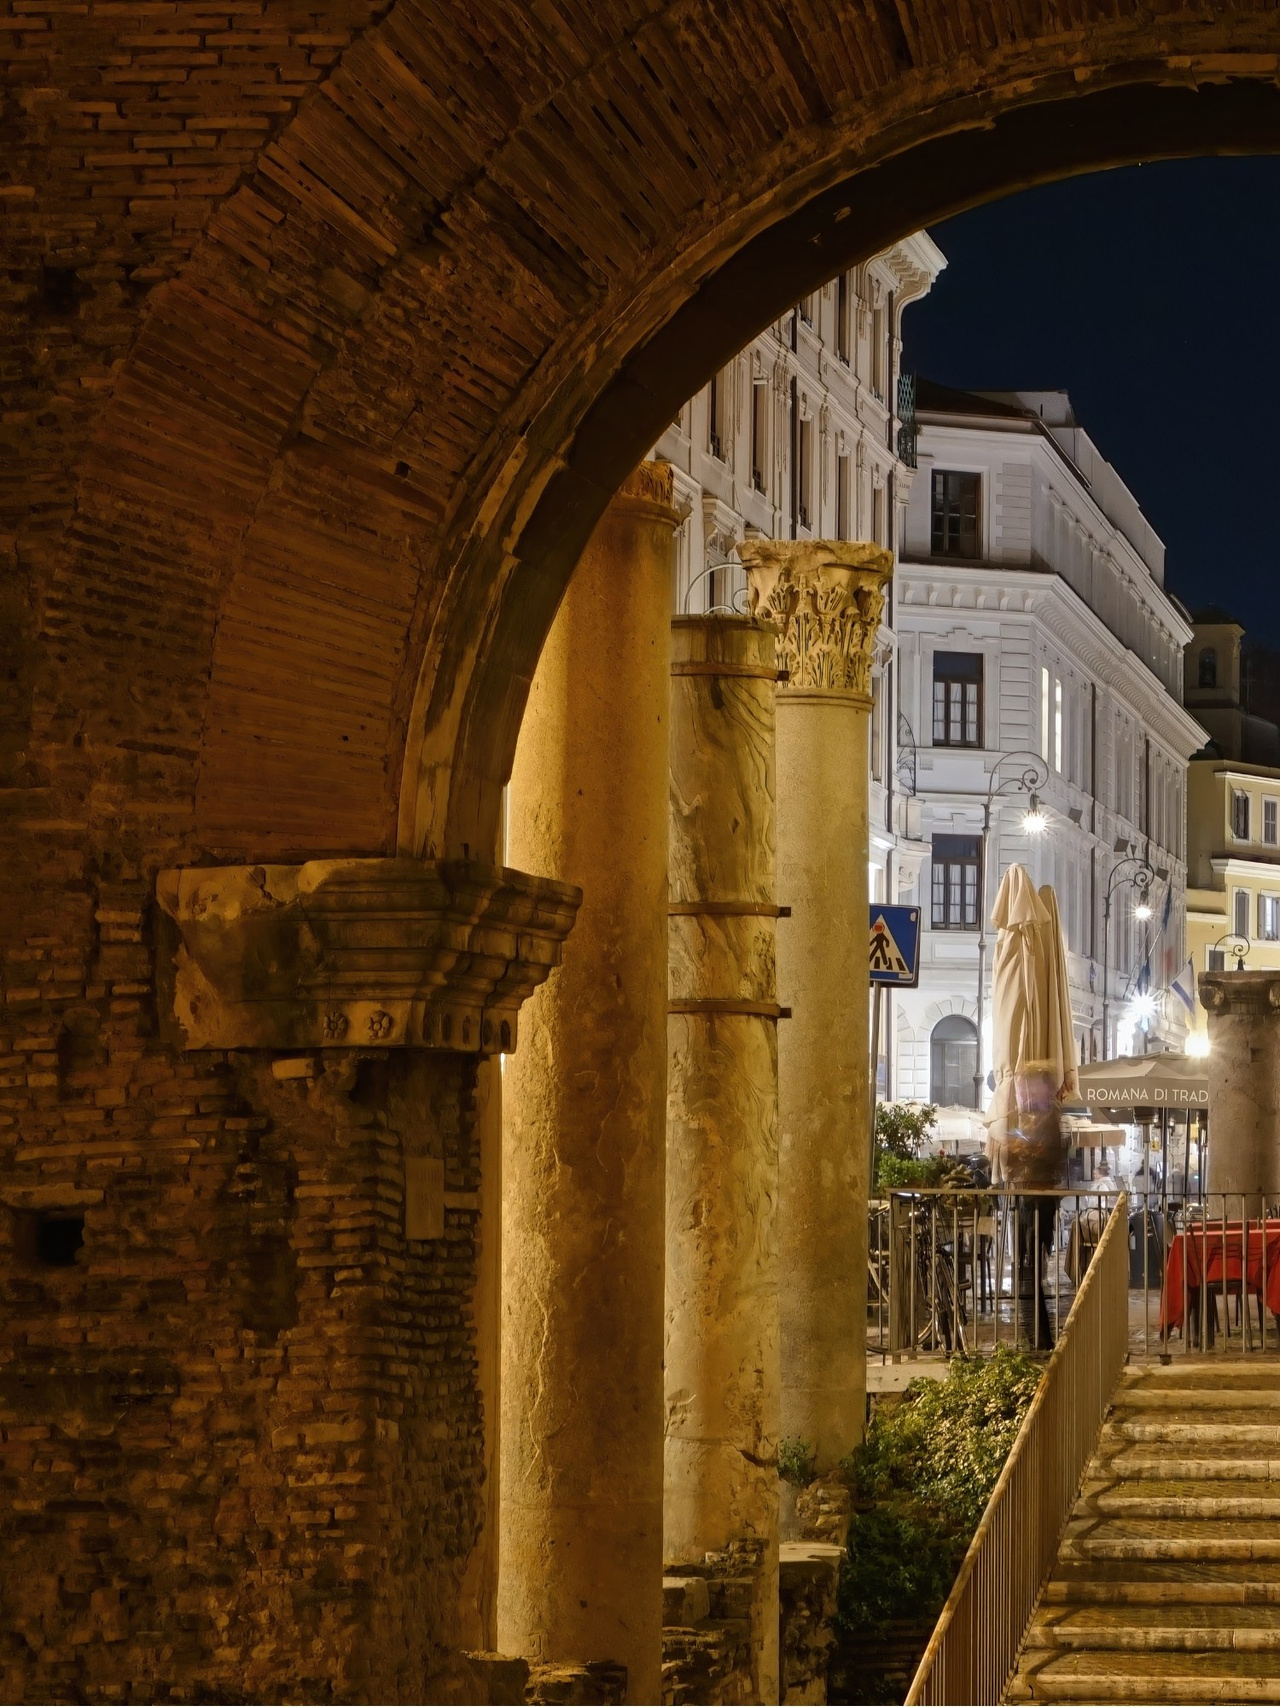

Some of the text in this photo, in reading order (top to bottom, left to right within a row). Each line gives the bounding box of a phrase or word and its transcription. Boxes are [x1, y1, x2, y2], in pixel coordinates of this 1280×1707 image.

[1087, 1088, 1149, 1101] ROMANA
[1154, 1088, 1168, 1101] DI
[1172, 1089, 1209, 1103] TRAD
